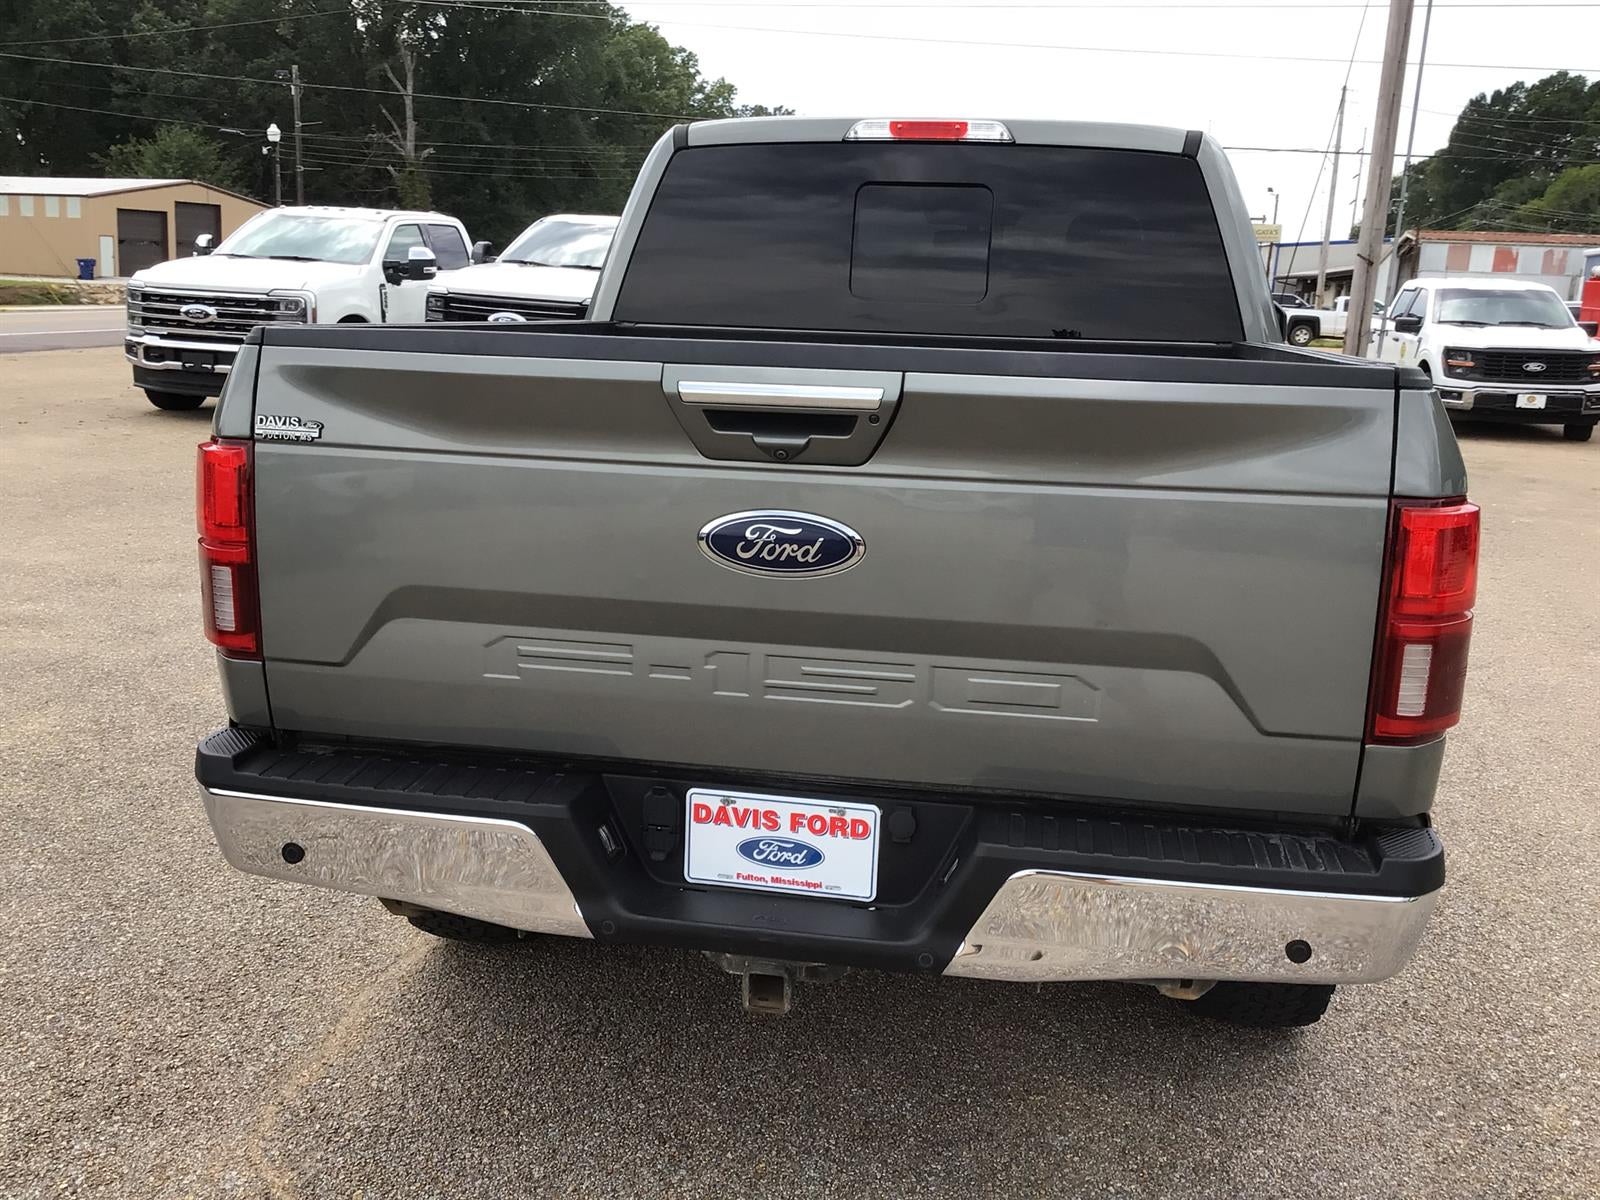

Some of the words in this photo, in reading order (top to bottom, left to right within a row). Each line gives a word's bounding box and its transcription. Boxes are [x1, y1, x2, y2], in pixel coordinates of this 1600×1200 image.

[257, 415, 299, 428] DAVIS
[736, 523, 824, 563] Ford
[483, 635, 1100, 722] F-150
[693, 803, 780, 832] DAVIS
[789, 811, 872, 840] FORD
[753, 839, 807, 865] Ford
[736, 872, 768, 884] Fulton,
[770, 876, 823, 890] Mississippi
